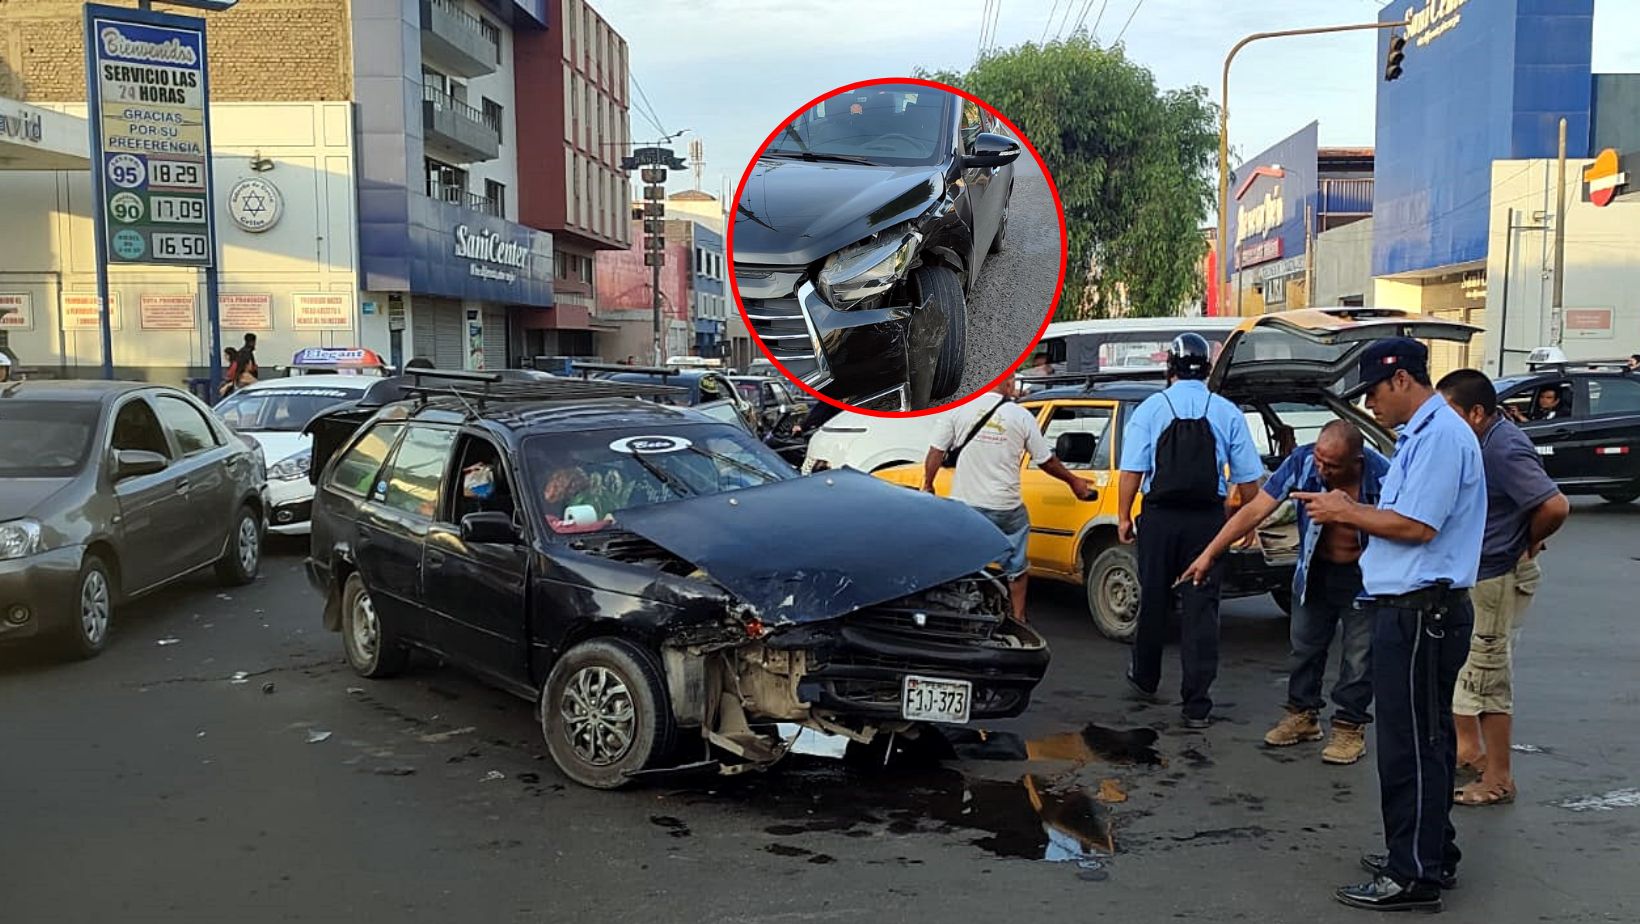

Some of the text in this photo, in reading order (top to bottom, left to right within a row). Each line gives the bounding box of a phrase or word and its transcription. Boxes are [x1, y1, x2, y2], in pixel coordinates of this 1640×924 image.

[102, 28, 196, 64] Bienvenidos
[104, 64, 197, 88] SERVICIO LAS
[139, 85, 186, 104] HORAS
[123, 108, 183, 124] GRACIAS
[129, 123, 178, 137] POR SU
[109, 136, 200, 153] PREFERENCIA
[113, 166, 137, 184] 95
[153, 164, 198, 183] 18.29
[115, 203, 140, 219] 90
[157, 200, 203, 220] 17.09
[159, 236, 205, 255] 16.50
[455, 225, 529, 268] SaniCenter
[304, 349, 364, 360] Elegant
[907, 688, 964, 714] F1J-373
